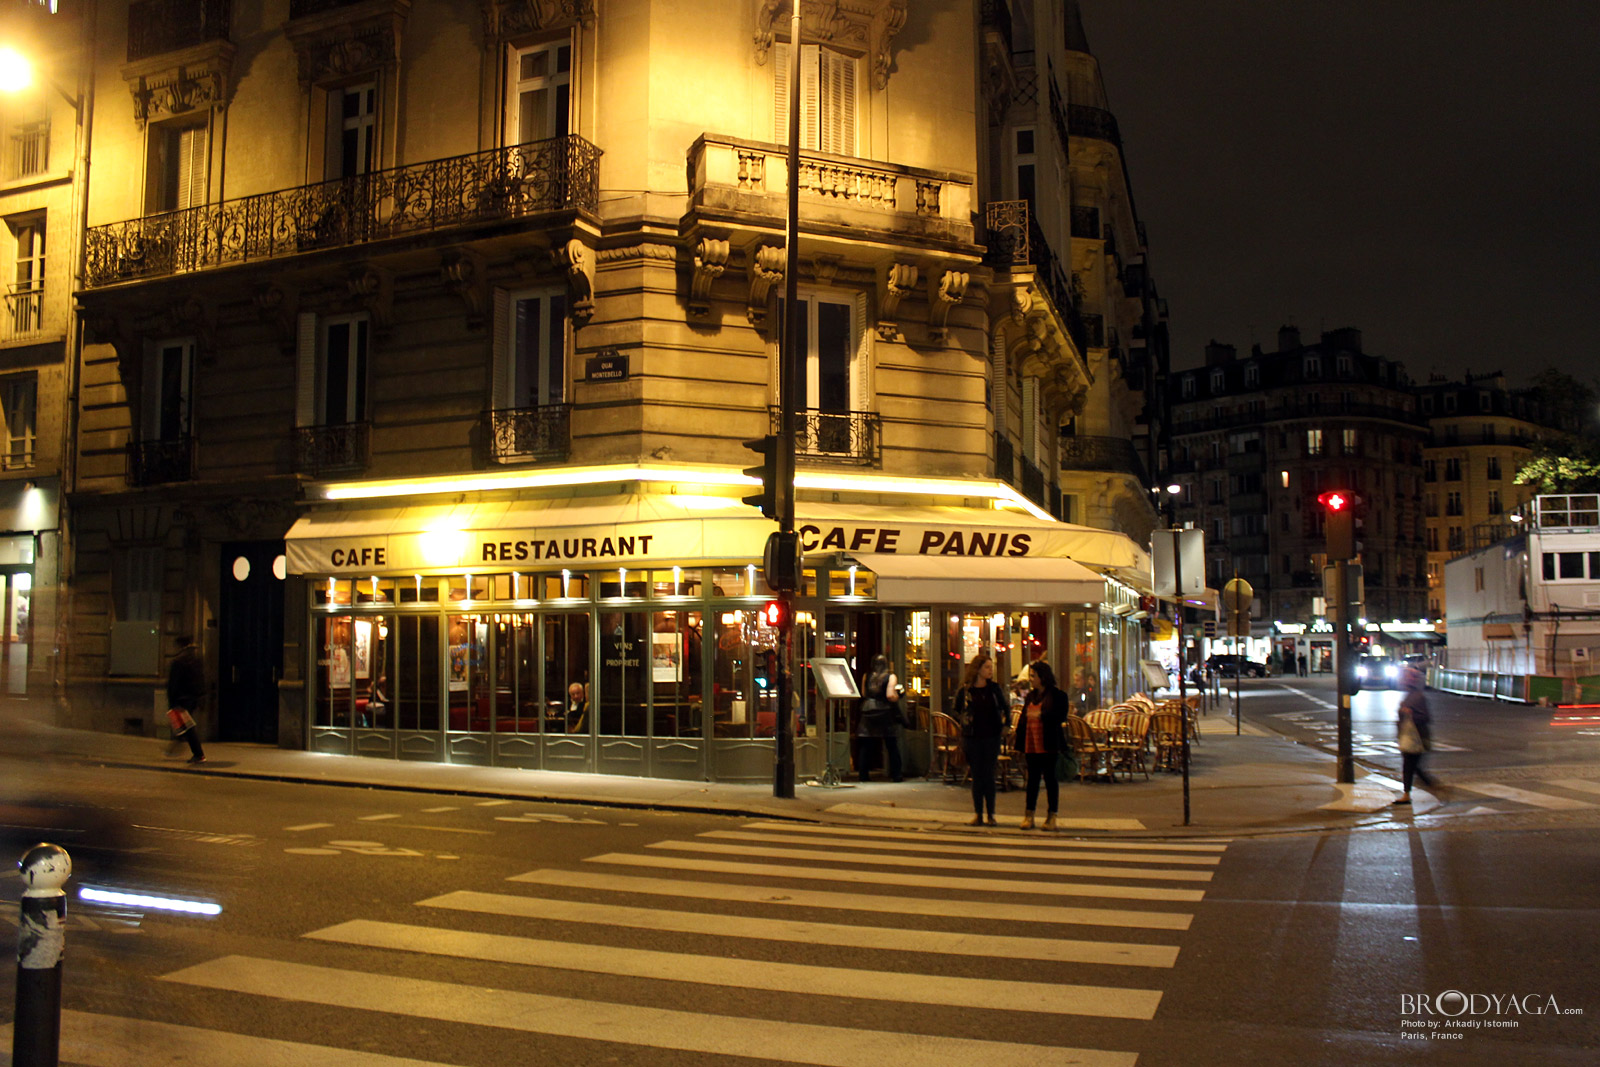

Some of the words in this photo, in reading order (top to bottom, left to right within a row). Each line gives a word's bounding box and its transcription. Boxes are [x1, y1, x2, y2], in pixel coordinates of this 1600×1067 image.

[330, 547, 386, 568] CAFE
[481, 535, 653, 562] RESTAURANT
[799, 524, 901, 553] CAFE
[919, 530, 1032, 557] PANIS
